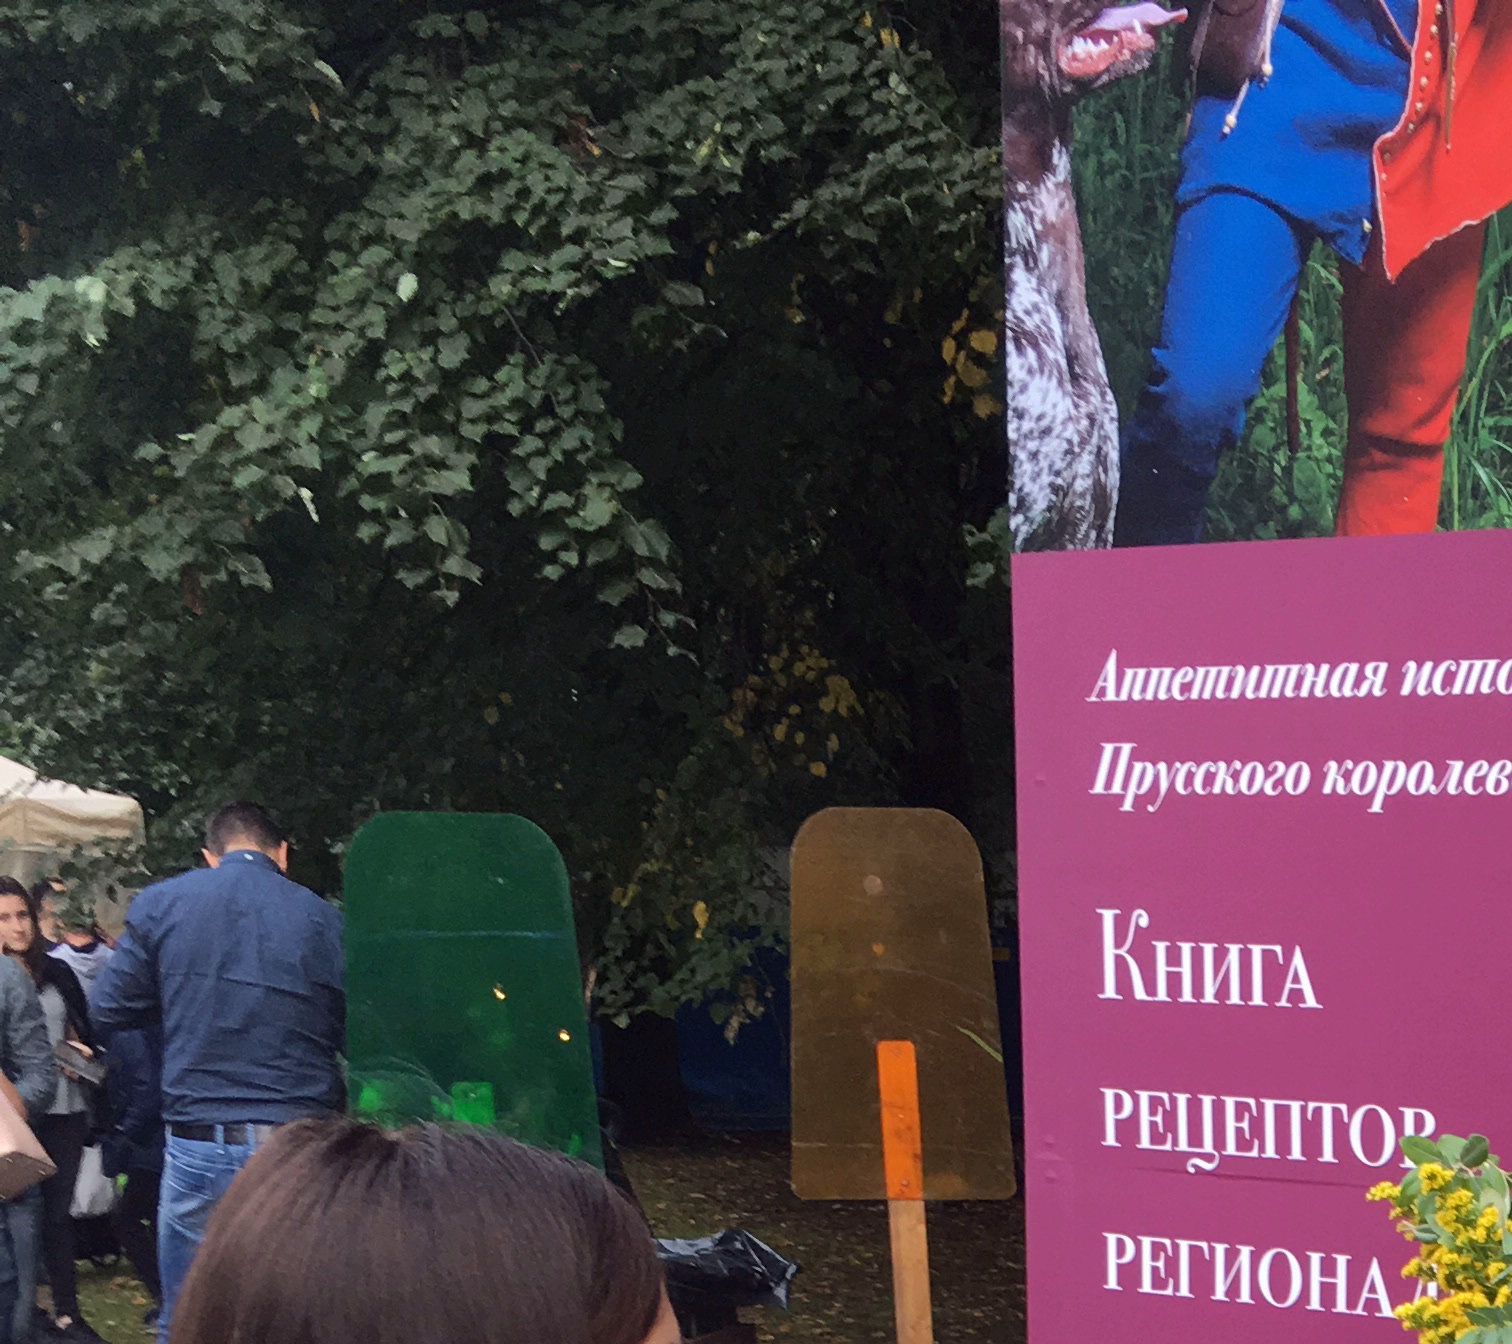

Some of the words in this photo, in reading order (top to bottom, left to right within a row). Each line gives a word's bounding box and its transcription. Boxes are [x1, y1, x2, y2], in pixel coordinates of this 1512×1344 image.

[1085, 648, 1388, 702] Аппетитная
[1088, 742, 1311, 812] Прусского
[1101, 1232, 1442, 1319] РЕГИОНА
